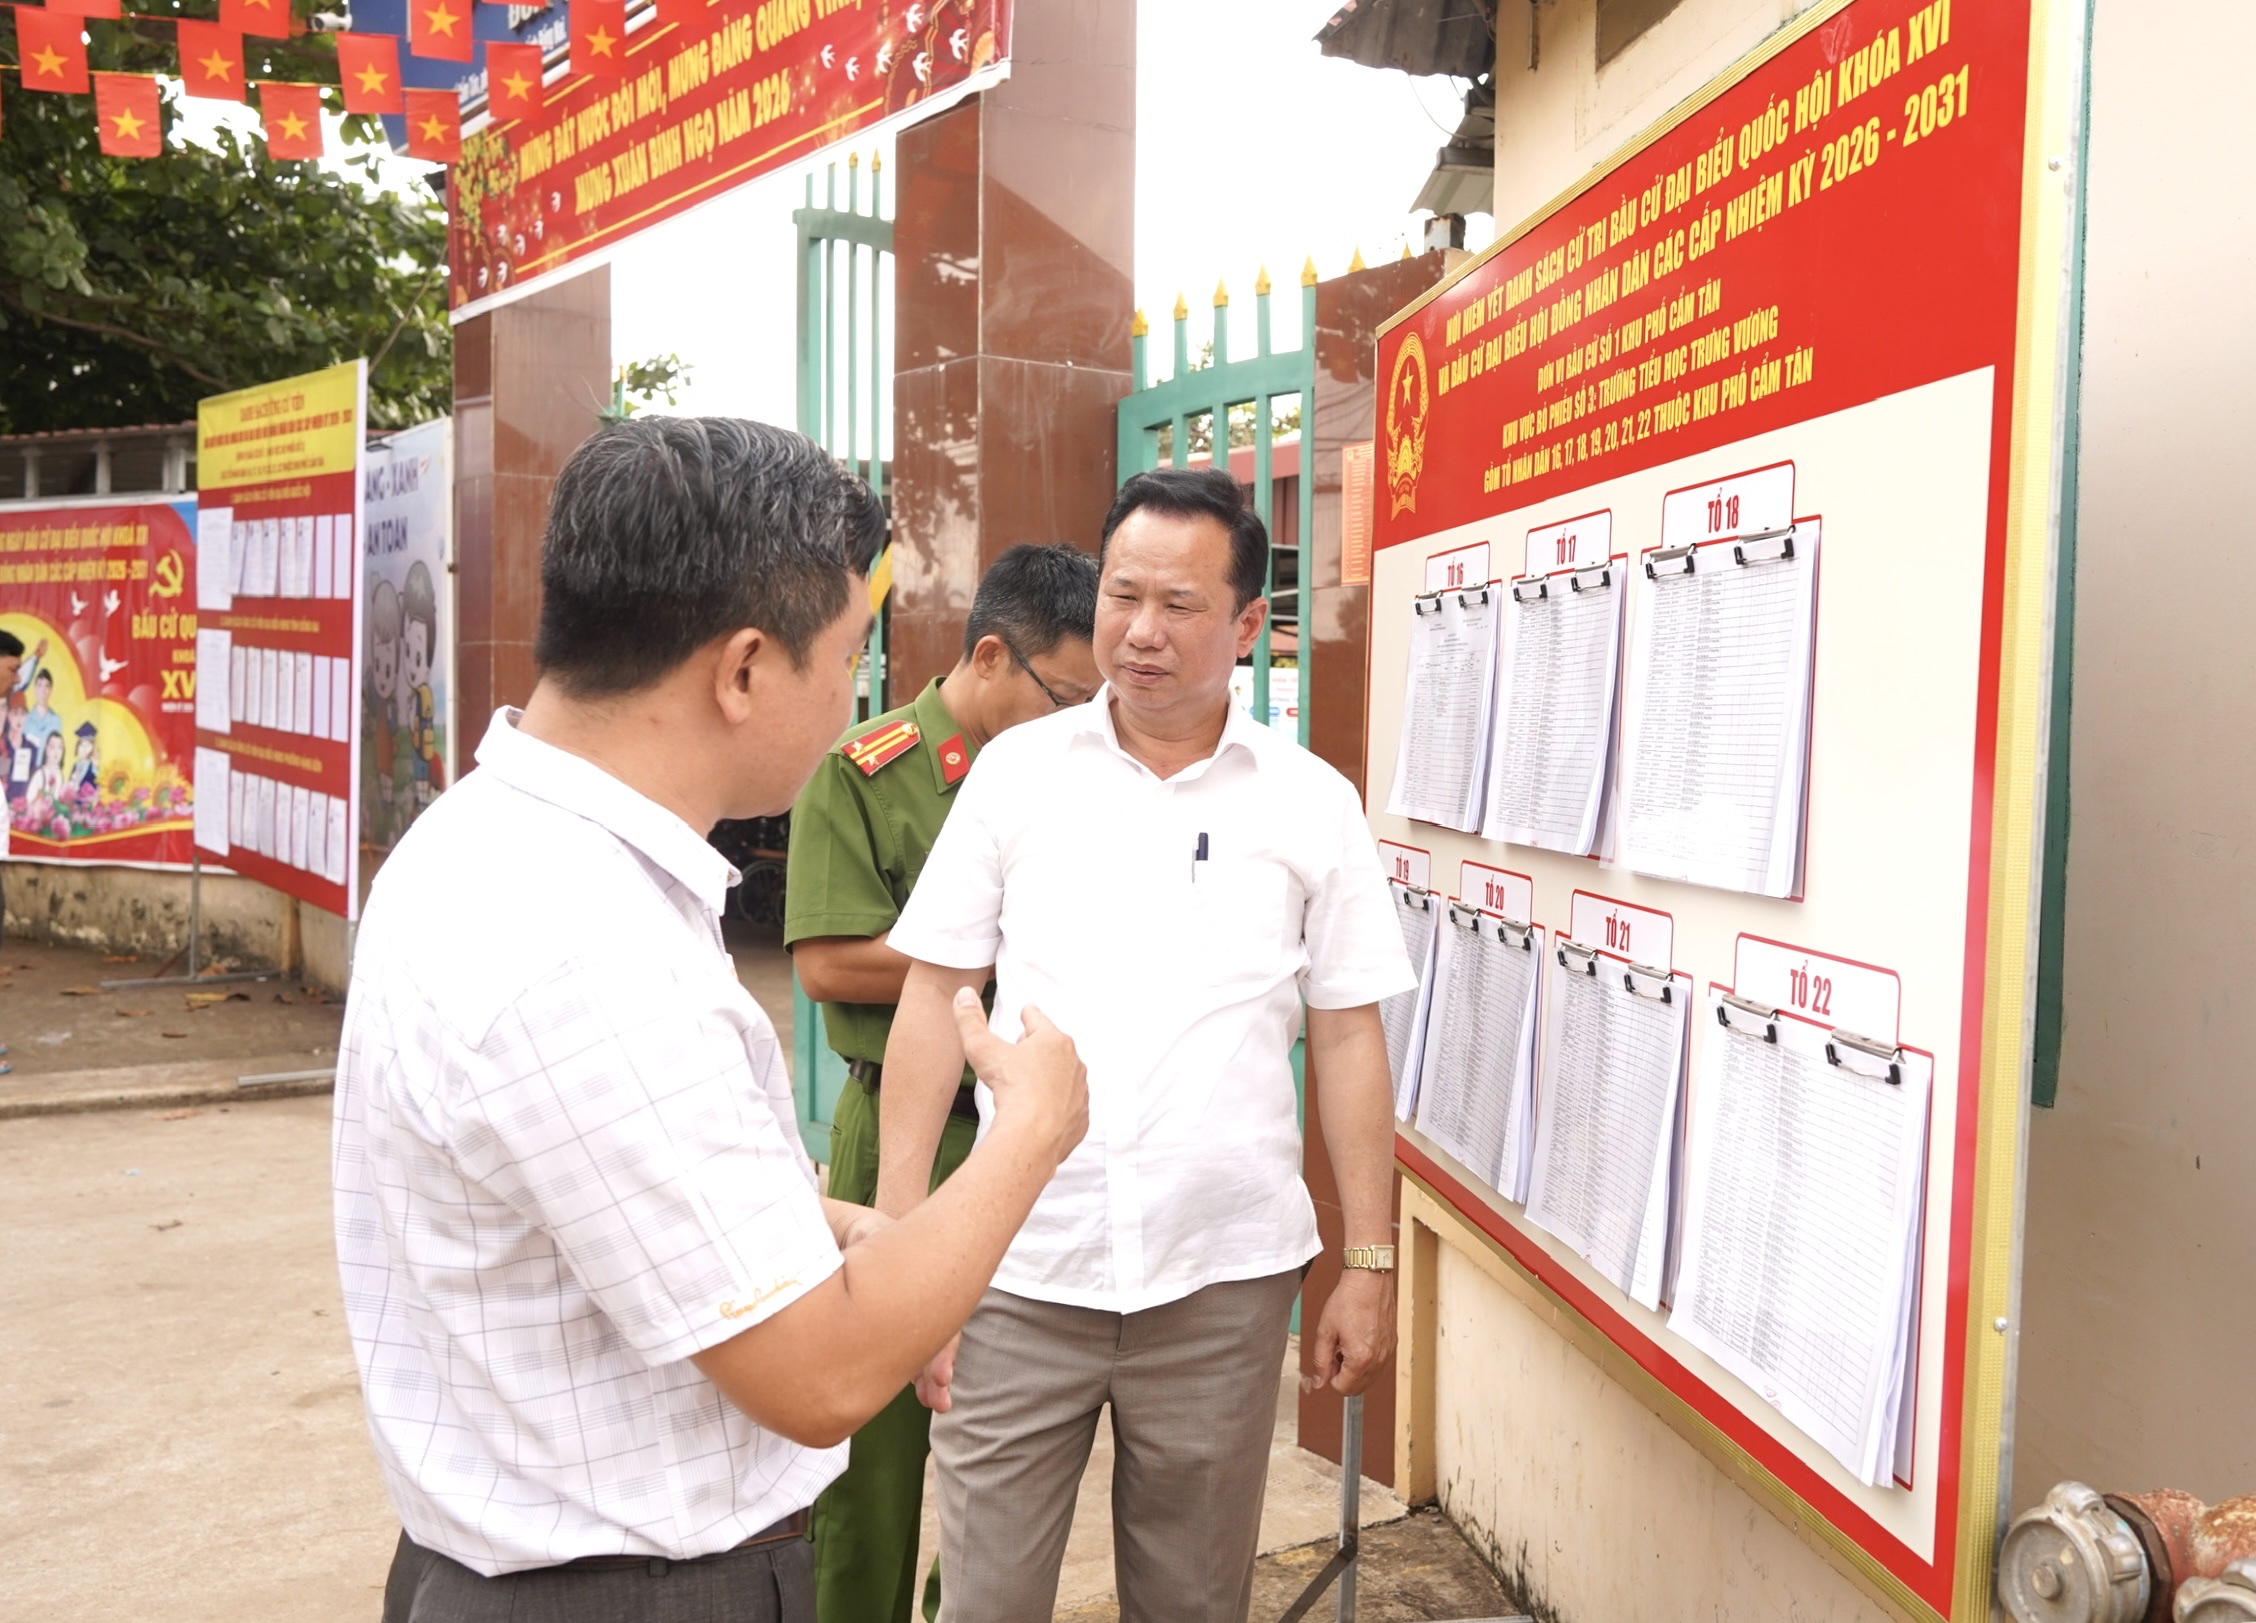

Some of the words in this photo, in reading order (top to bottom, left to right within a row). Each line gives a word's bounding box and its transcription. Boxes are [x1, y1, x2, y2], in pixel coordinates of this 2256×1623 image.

[575, 162, 612, 216] MỪNG
[612, 140, 648, 198] XUÂN
[649, 124, 682, 180] BÍNH
[683, 108, 715, 164] NGỌ
[716, 87, 752, 146] NĂM
[752, 68, 791, 128] 2026
[1487, 278, 1504, 322] YẾT
[1506, 266, 1533, 312] DANH
[1535, 246, 1564, 294] SÁCH
[1567, 226, 1585, 273] CỬ
[1587, 217, 1607, 261] TRI
[1610, 194, 1637, 248] BẦU
[1641, 174, 1664, 228] CỬ
[1664, 162, 1692, 214] ĐẠI
[1696, 126, 1734, 196] BIỂU
[1738, 93, 1789, 170] QUỐC
[1795, 69, 1832, 134] HỘI
[1838, 27, 1900, 108] KHÓA
[1907, 0, 1950, 66] XVI
[1438, 360, 1450, 396] VÀ
[1451, 349, 1469, 388] BẦU
[1471, 339, 1485, 378] CỬ
[1486, 334, 1502, 372] ĐẠI
[1504, 313, 1527, 361] BIỂU
[1530, 306, 1548, 349] HỘI
[1550, 288, 1582, 336] ĐỒNG
[1584, 267, 1618, 318] NHÂN
[1622, 249, 1650, 298] DÂN
[1654, 229, 1684, 280] CÁC
[1688, 201, 1722, 261] CẤP
[1726, 171, 1784, 242] NHIỆM
[1788, 148, 1816, 208] KỲ
[1820, 116, 1880, 192] 2026
[1886, 128, 1896, 142] -
[1903, 64, 1969, 148] 2031
[1538, 361, 1554, 394] ĐƠN
[1556, 357, 1564, 386] VỊ
[1566, 343, 1583, 380] BẦU
[1585, 334, 1600, 370] CỬ
[1600, 323, 1612, 364] SỐ
[1614, 329, 1620, 357] 1
[1622, 318, 1642, 354] KHU
[1645, 296, 1666, 344] PHỐ
[1669, 286, 1695, 332] CẨM
[1698, 278, 1721, 318] TÂN
[1502, 420, 1518, 450] KHU
[1520, 411, 1534, 444] VỰC
[1536, 402, 1548, 435] BỎ
[1549, 388, 1573, 430] PHIẾU
[1574, 380, 1586, 419] SỐ
[1588, 385, 1597, 414] 3:
[1598, 367, 1636, 410] TRƯỜNG
[1639, 348, 1662, 392] TIỂU
[1664, 346, 1688, 384] HỌC
[1691, 326, 1730, 372] TRƯNG
[1734, 305, 1778, 354] VƯƠNG
[1484, 461, 1500, 494] GỒM
[1501, 454, 1512, 488] TỔ
[1512, 452, 1532, 484] NHÂN
[1534, 445, 1550, 478] DÂN
[1552, 443, 1562, 470] 16,
[1564, 438, 1574, 467] 17,
[1576, 433, 1588, 462] 18,
[1590, 428, 1602, 456] 19,
[1604, 421, 1618, 451] 20,
[1621, 416, 1634, 446] 21,
[1637, 408, 1652, 440] 22
[1654, 391, 1690, 434] THUỘC
[1693, 382, 1718, 422] KHU
[1721, 361, 1747, 412] PHỐ
[1750, 352, 1781, 402] CẨM
[1785, 346, 1813, 388] TÂN
[1708, 487, 1722, 534] TỔ
[1726, 495, 1739, 530] 18
[1557, 528, 1566, 565] TỔ
[1568, 535, 1576, 562] 17
[1456, 562, 1464, 586] 16
[161, 669, 196, 699] XV
[1396, 851, 1402, 878] TỔ
[1404, 860, 1409, 881] 19
[1486, 874, 1494, 908] TỔ
[1495, 884, 1504, 910] 20
[1606, 908, 1617, 948] TỔ
[1619, 920, 1630, 952] 21
[1790, 959, 1808, 1008] TỔ
[1812, 975, 1832, 1016] 22
